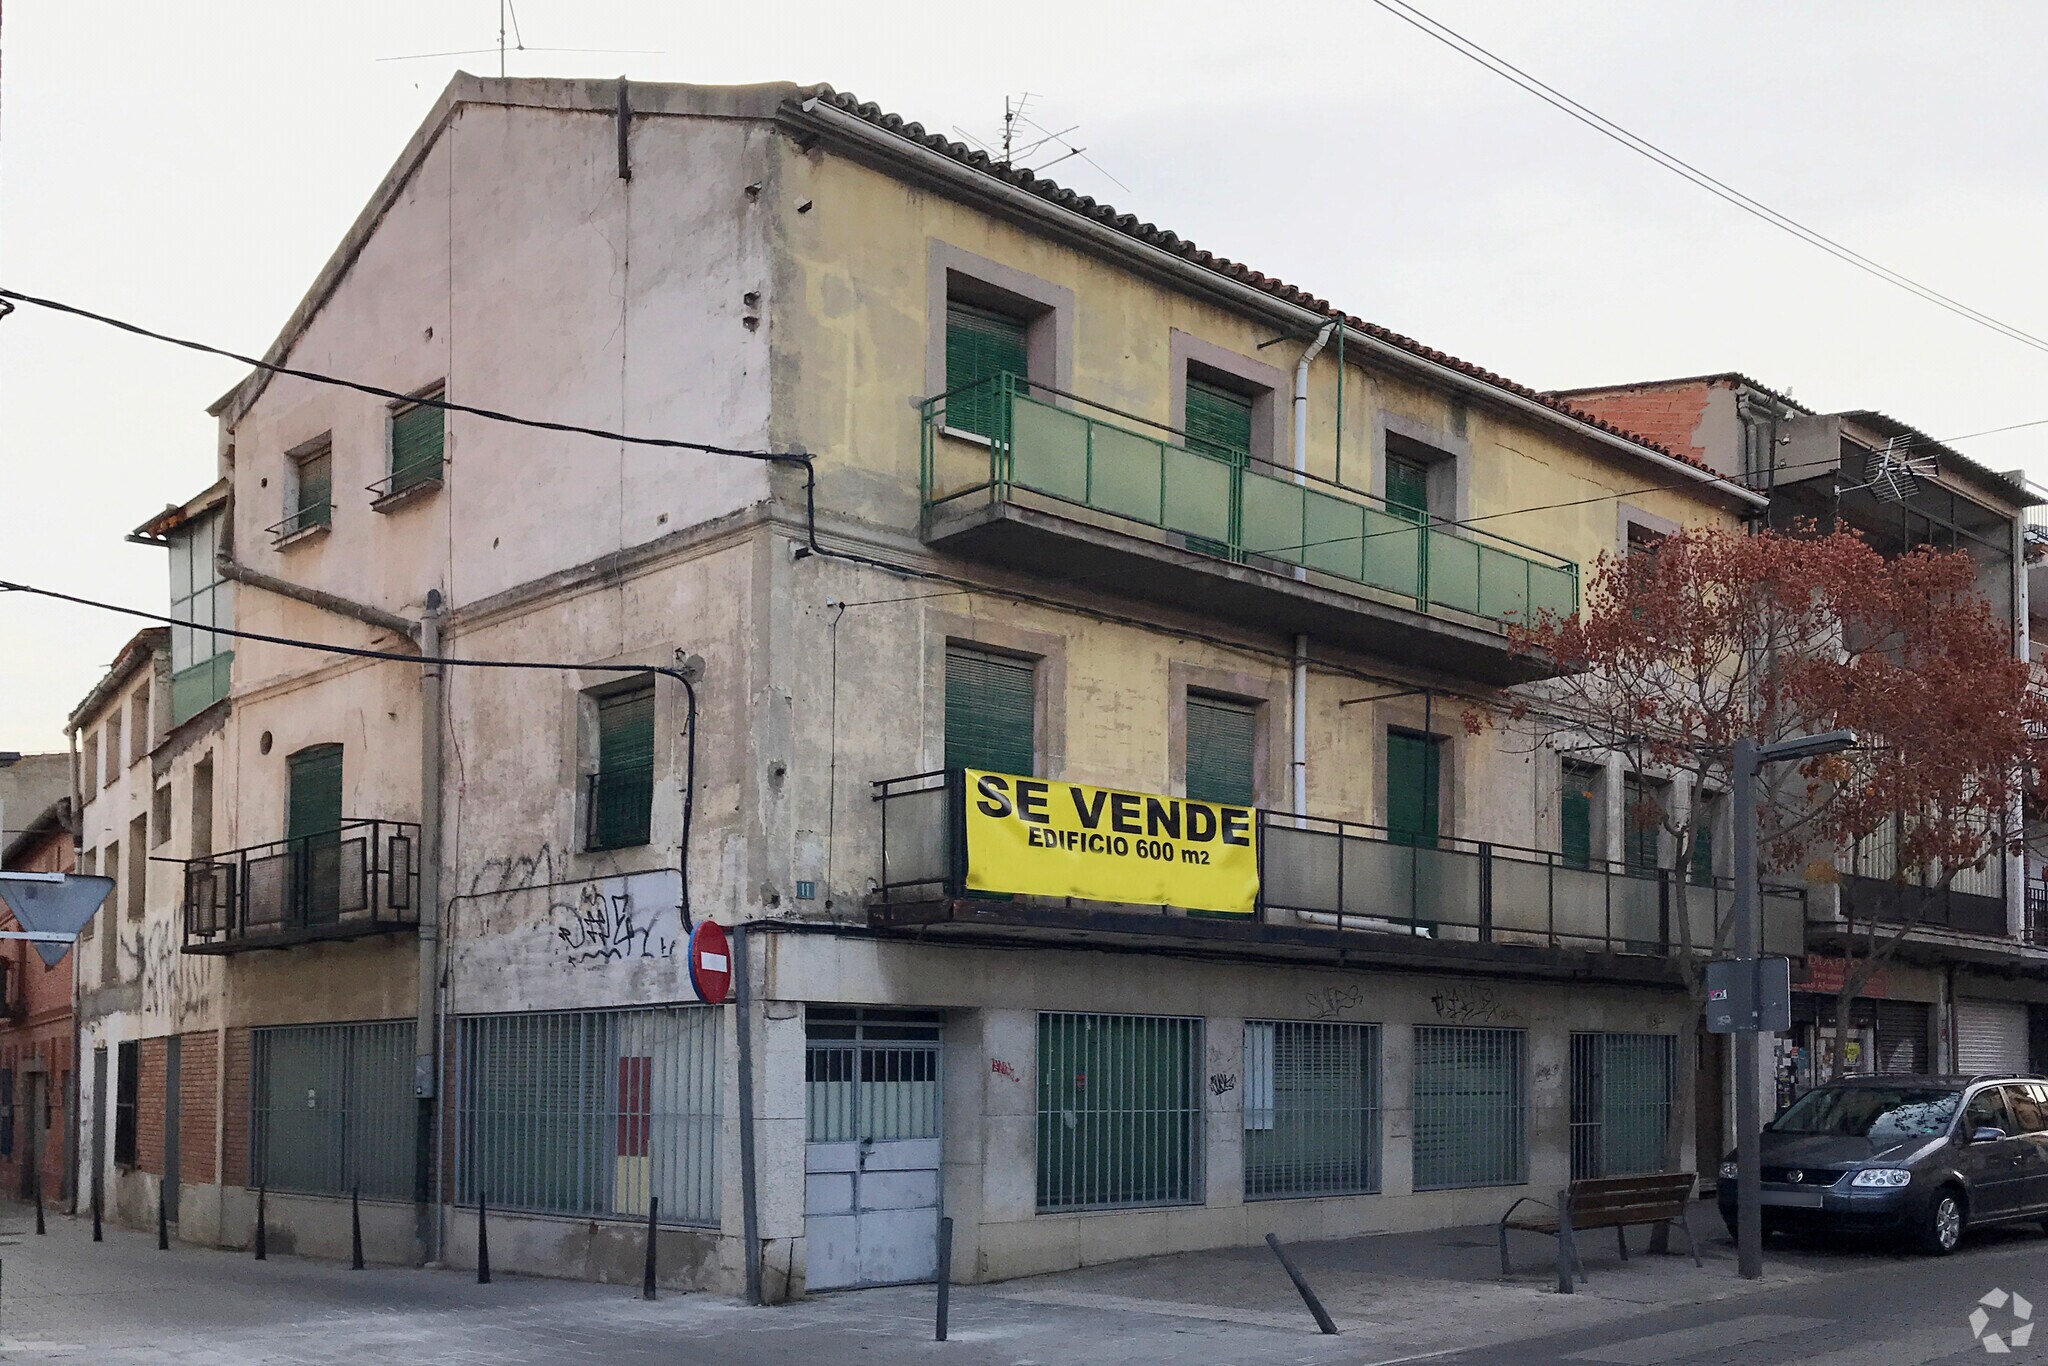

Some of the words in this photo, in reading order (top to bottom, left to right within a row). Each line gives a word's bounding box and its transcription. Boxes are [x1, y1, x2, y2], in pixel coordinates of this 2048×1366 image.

[976, 775, 1049, 824] SE
[1069, 787, 1250, 847] VENDE
[1028, 827, 1129, 855] EDIFICIO
[1136, 841, 1174, 862] 600
[1182, 849, 1211, 865] m2
